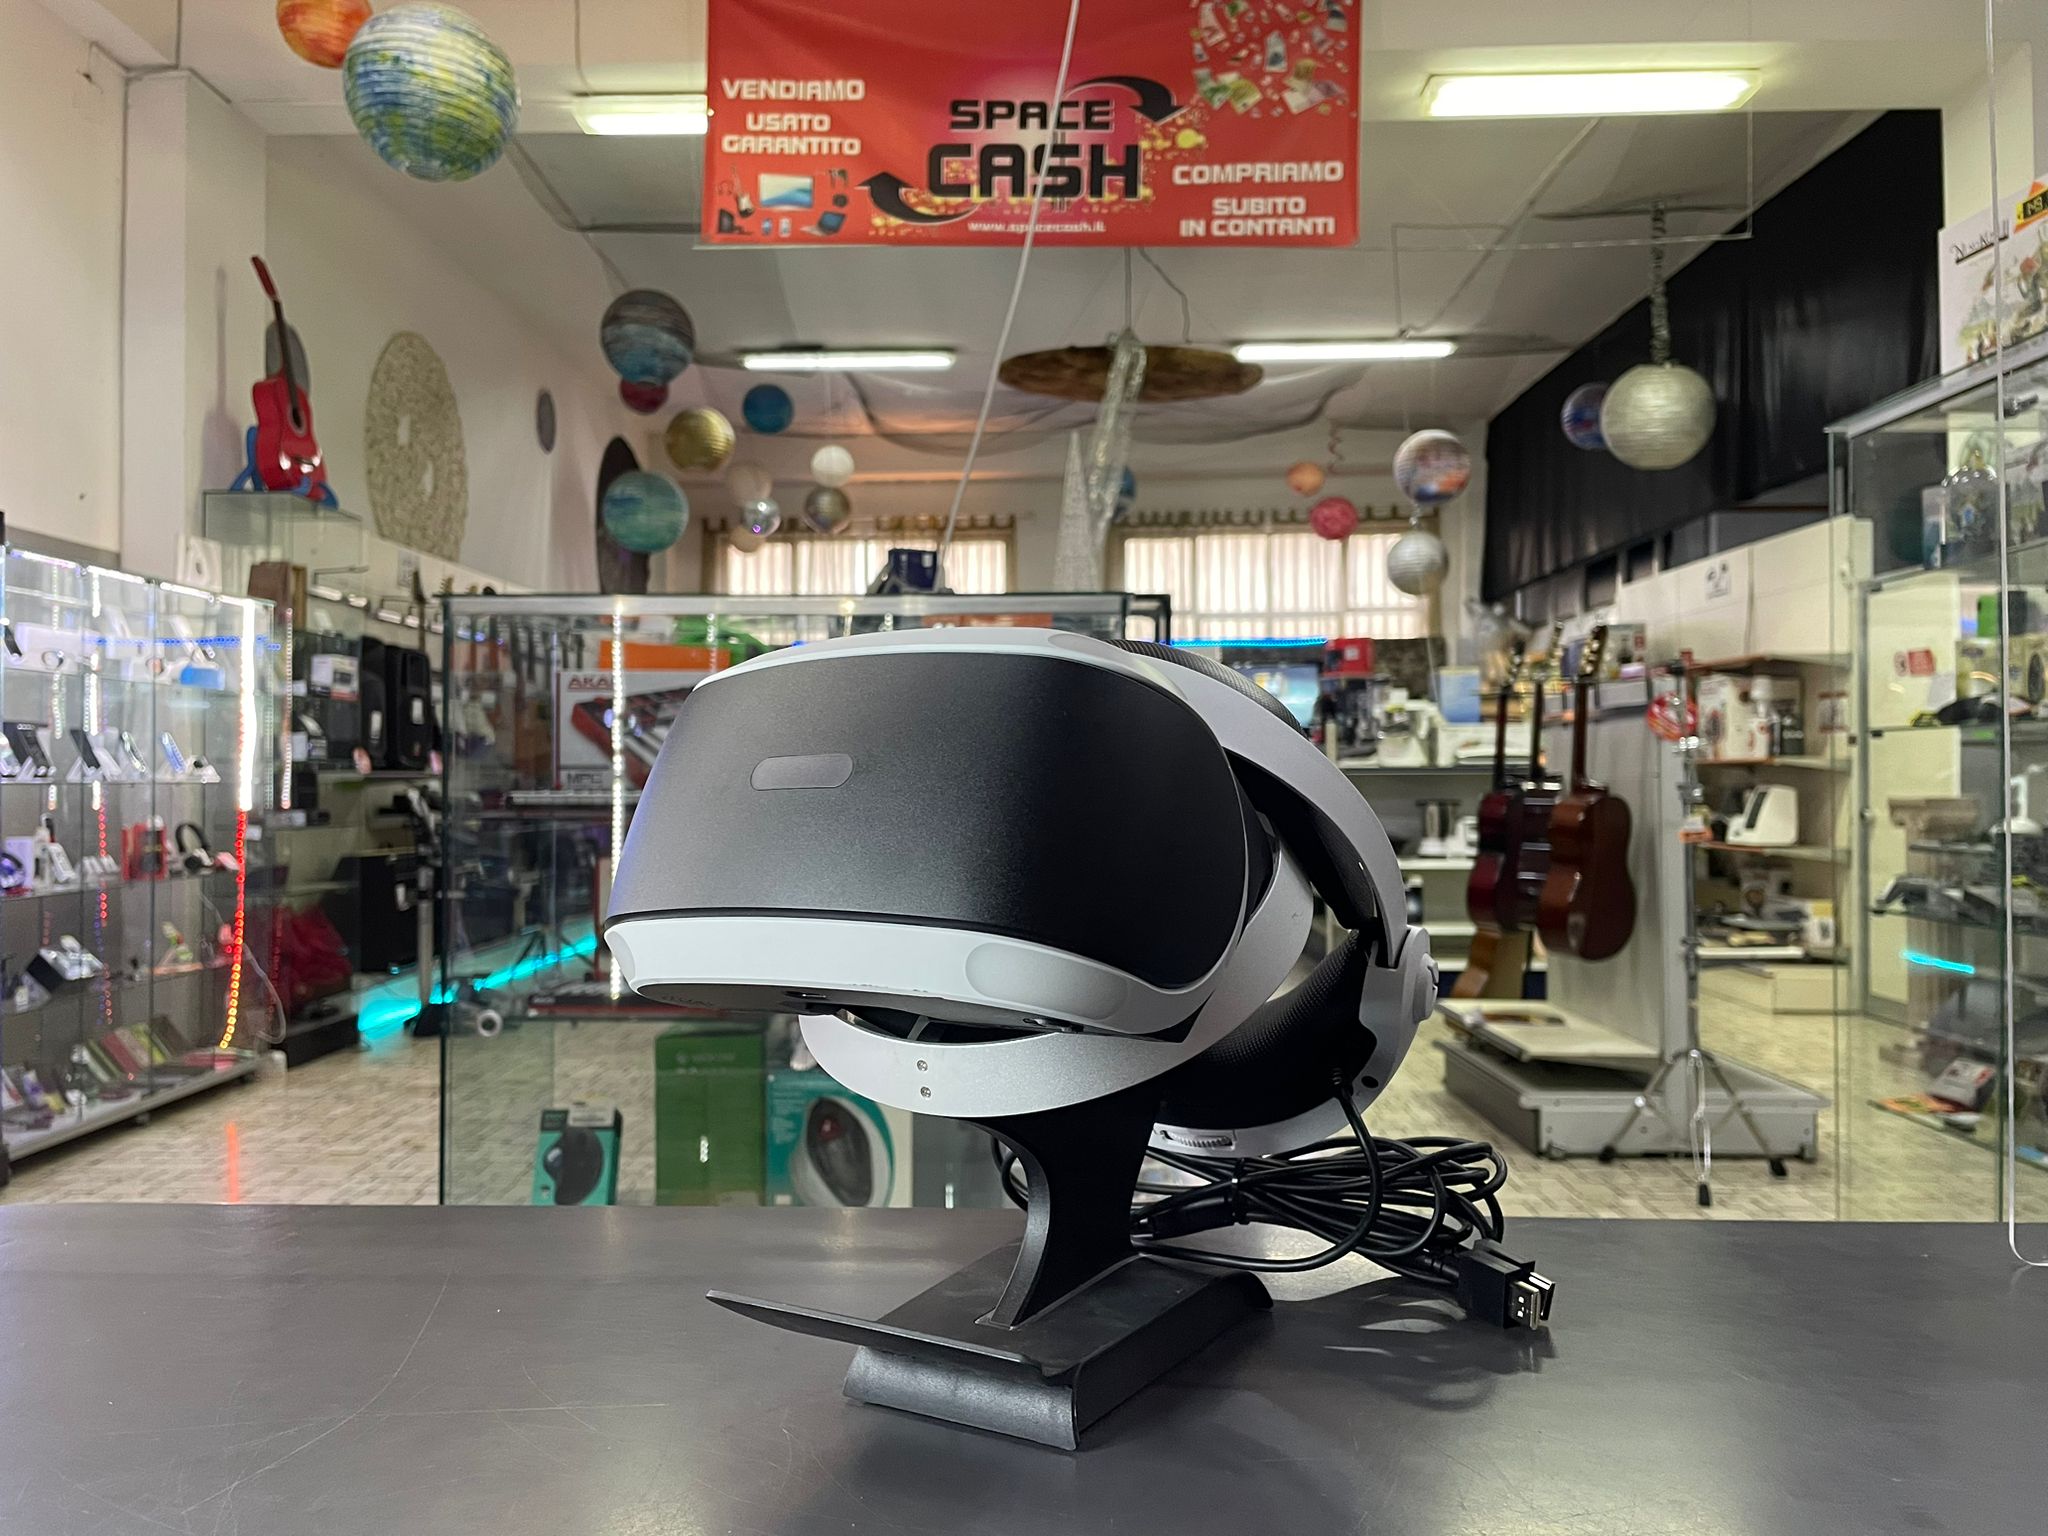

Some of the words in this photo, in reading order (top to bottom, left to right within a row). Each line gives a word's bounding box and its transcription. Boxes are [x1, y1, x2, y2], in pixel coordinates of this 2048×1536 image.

[721, 78, 865, 101] VENDIAMO
[746, 112, 831, 132] USATO
[950, 99, 1113, 131] SPACE
[721, 134, 862, 156] GARANTITO
[928, 143, 1141, 199] CASH
[1172, 160, 1345, 185] COMPRIAMO
[1212, 196, 1307, 216] SUBITO
[1179, 219, 1206, 237] IN
[1211, 217, 1336, 237] CONTANTI
